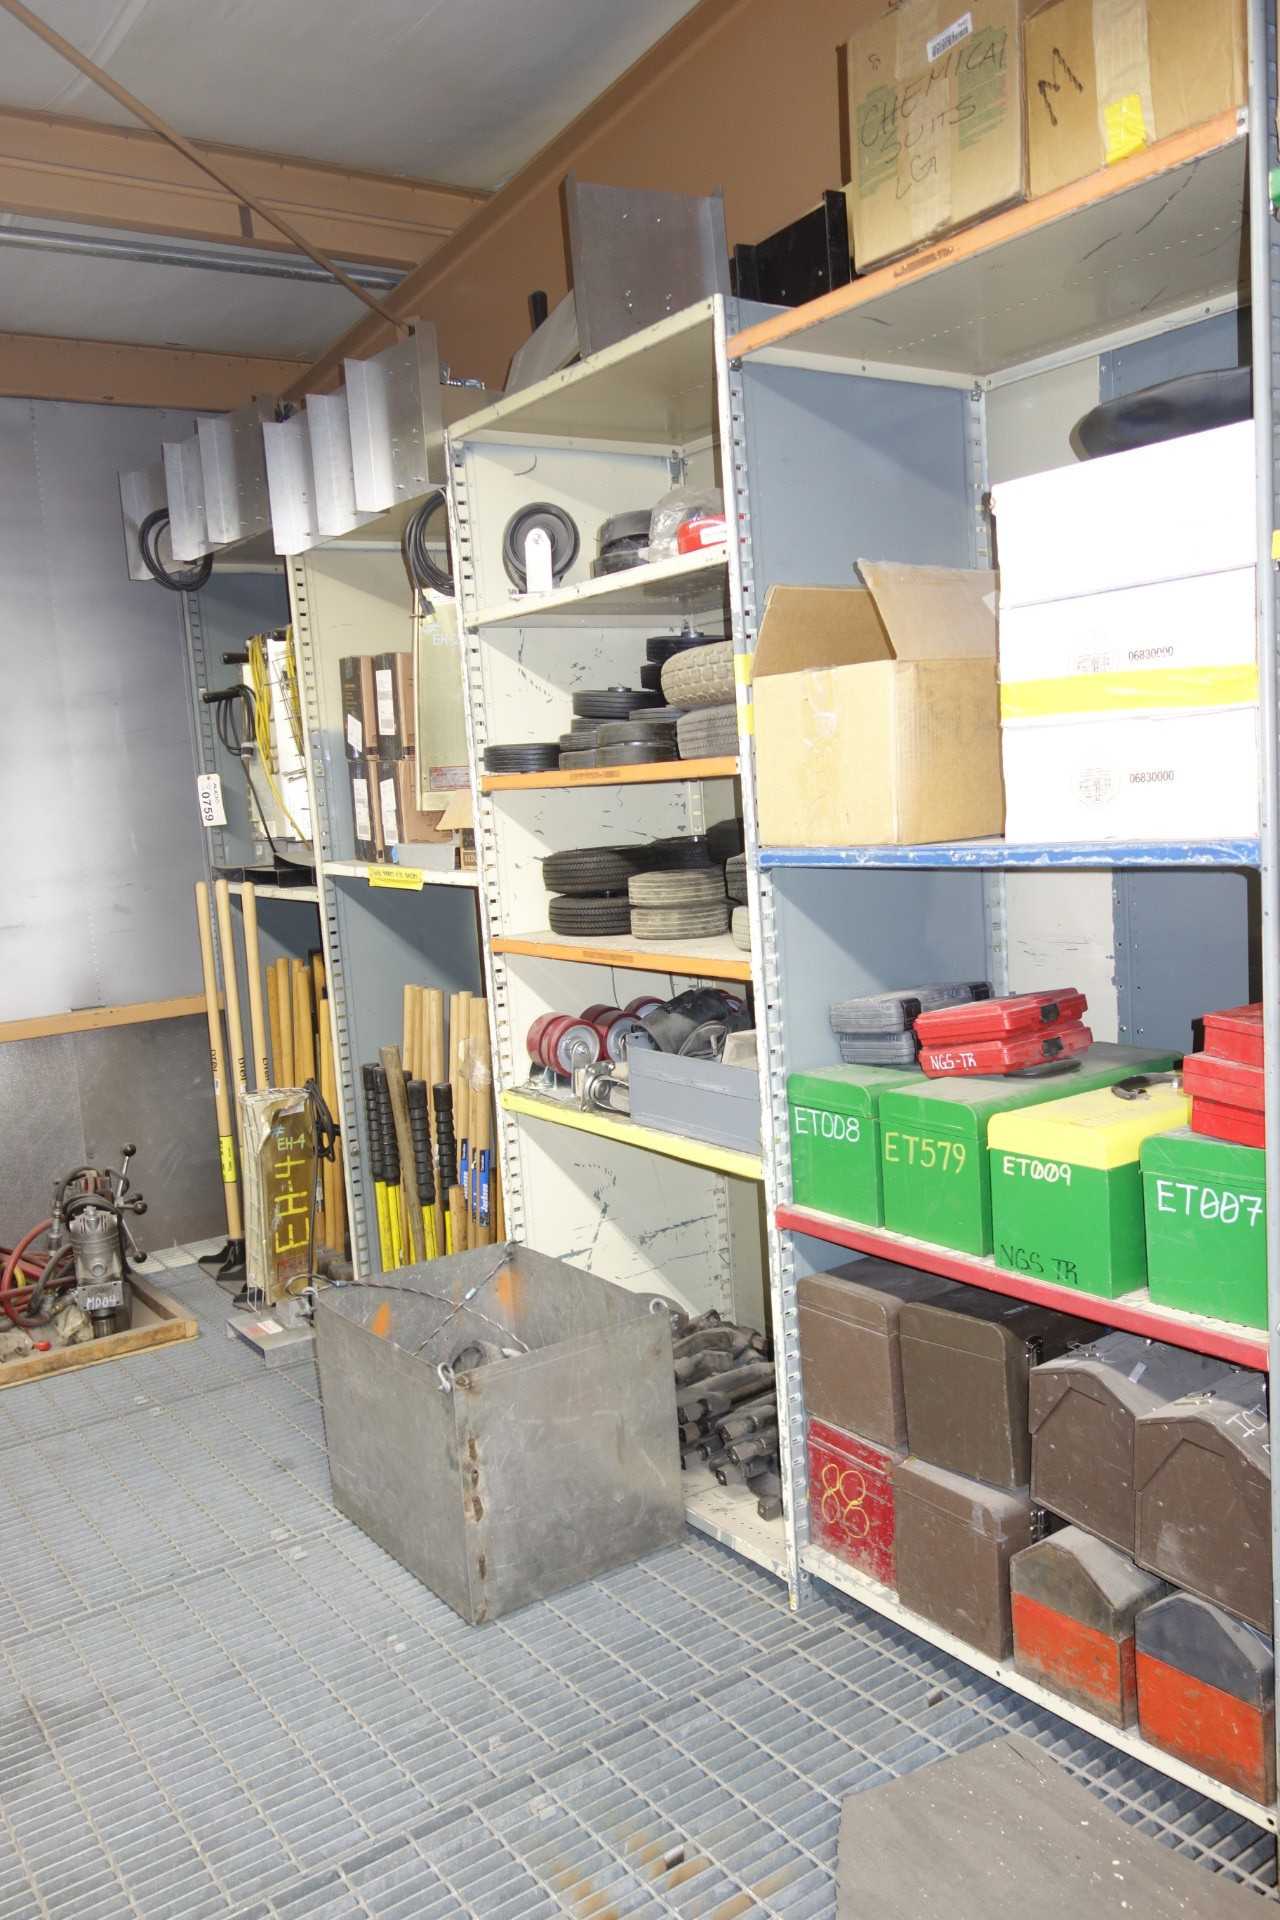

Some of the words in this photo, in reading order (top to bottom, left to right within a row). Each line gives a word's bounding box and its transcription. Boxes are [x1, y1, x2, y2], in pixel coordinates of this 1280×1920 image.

[1038, 47, 1084, 127] M
[880, 96, 976, 165] SUITS
[1129, 769, 1175, 784] 06830000
[201, 791, 215, 822] 0759
[930, 1051, 977, 1071] NGS-TR
[885, 1131, 966, 1174] ET579
[1003, 1155, 1072, 1186] ET009
[274, 1155, 310, 1254] EH-4
[1156, 1180, 1263, 1228] ET007
[1000, 1243, 1045, 1273] NGS
[1050, 1257, 1079, 1285] TR
